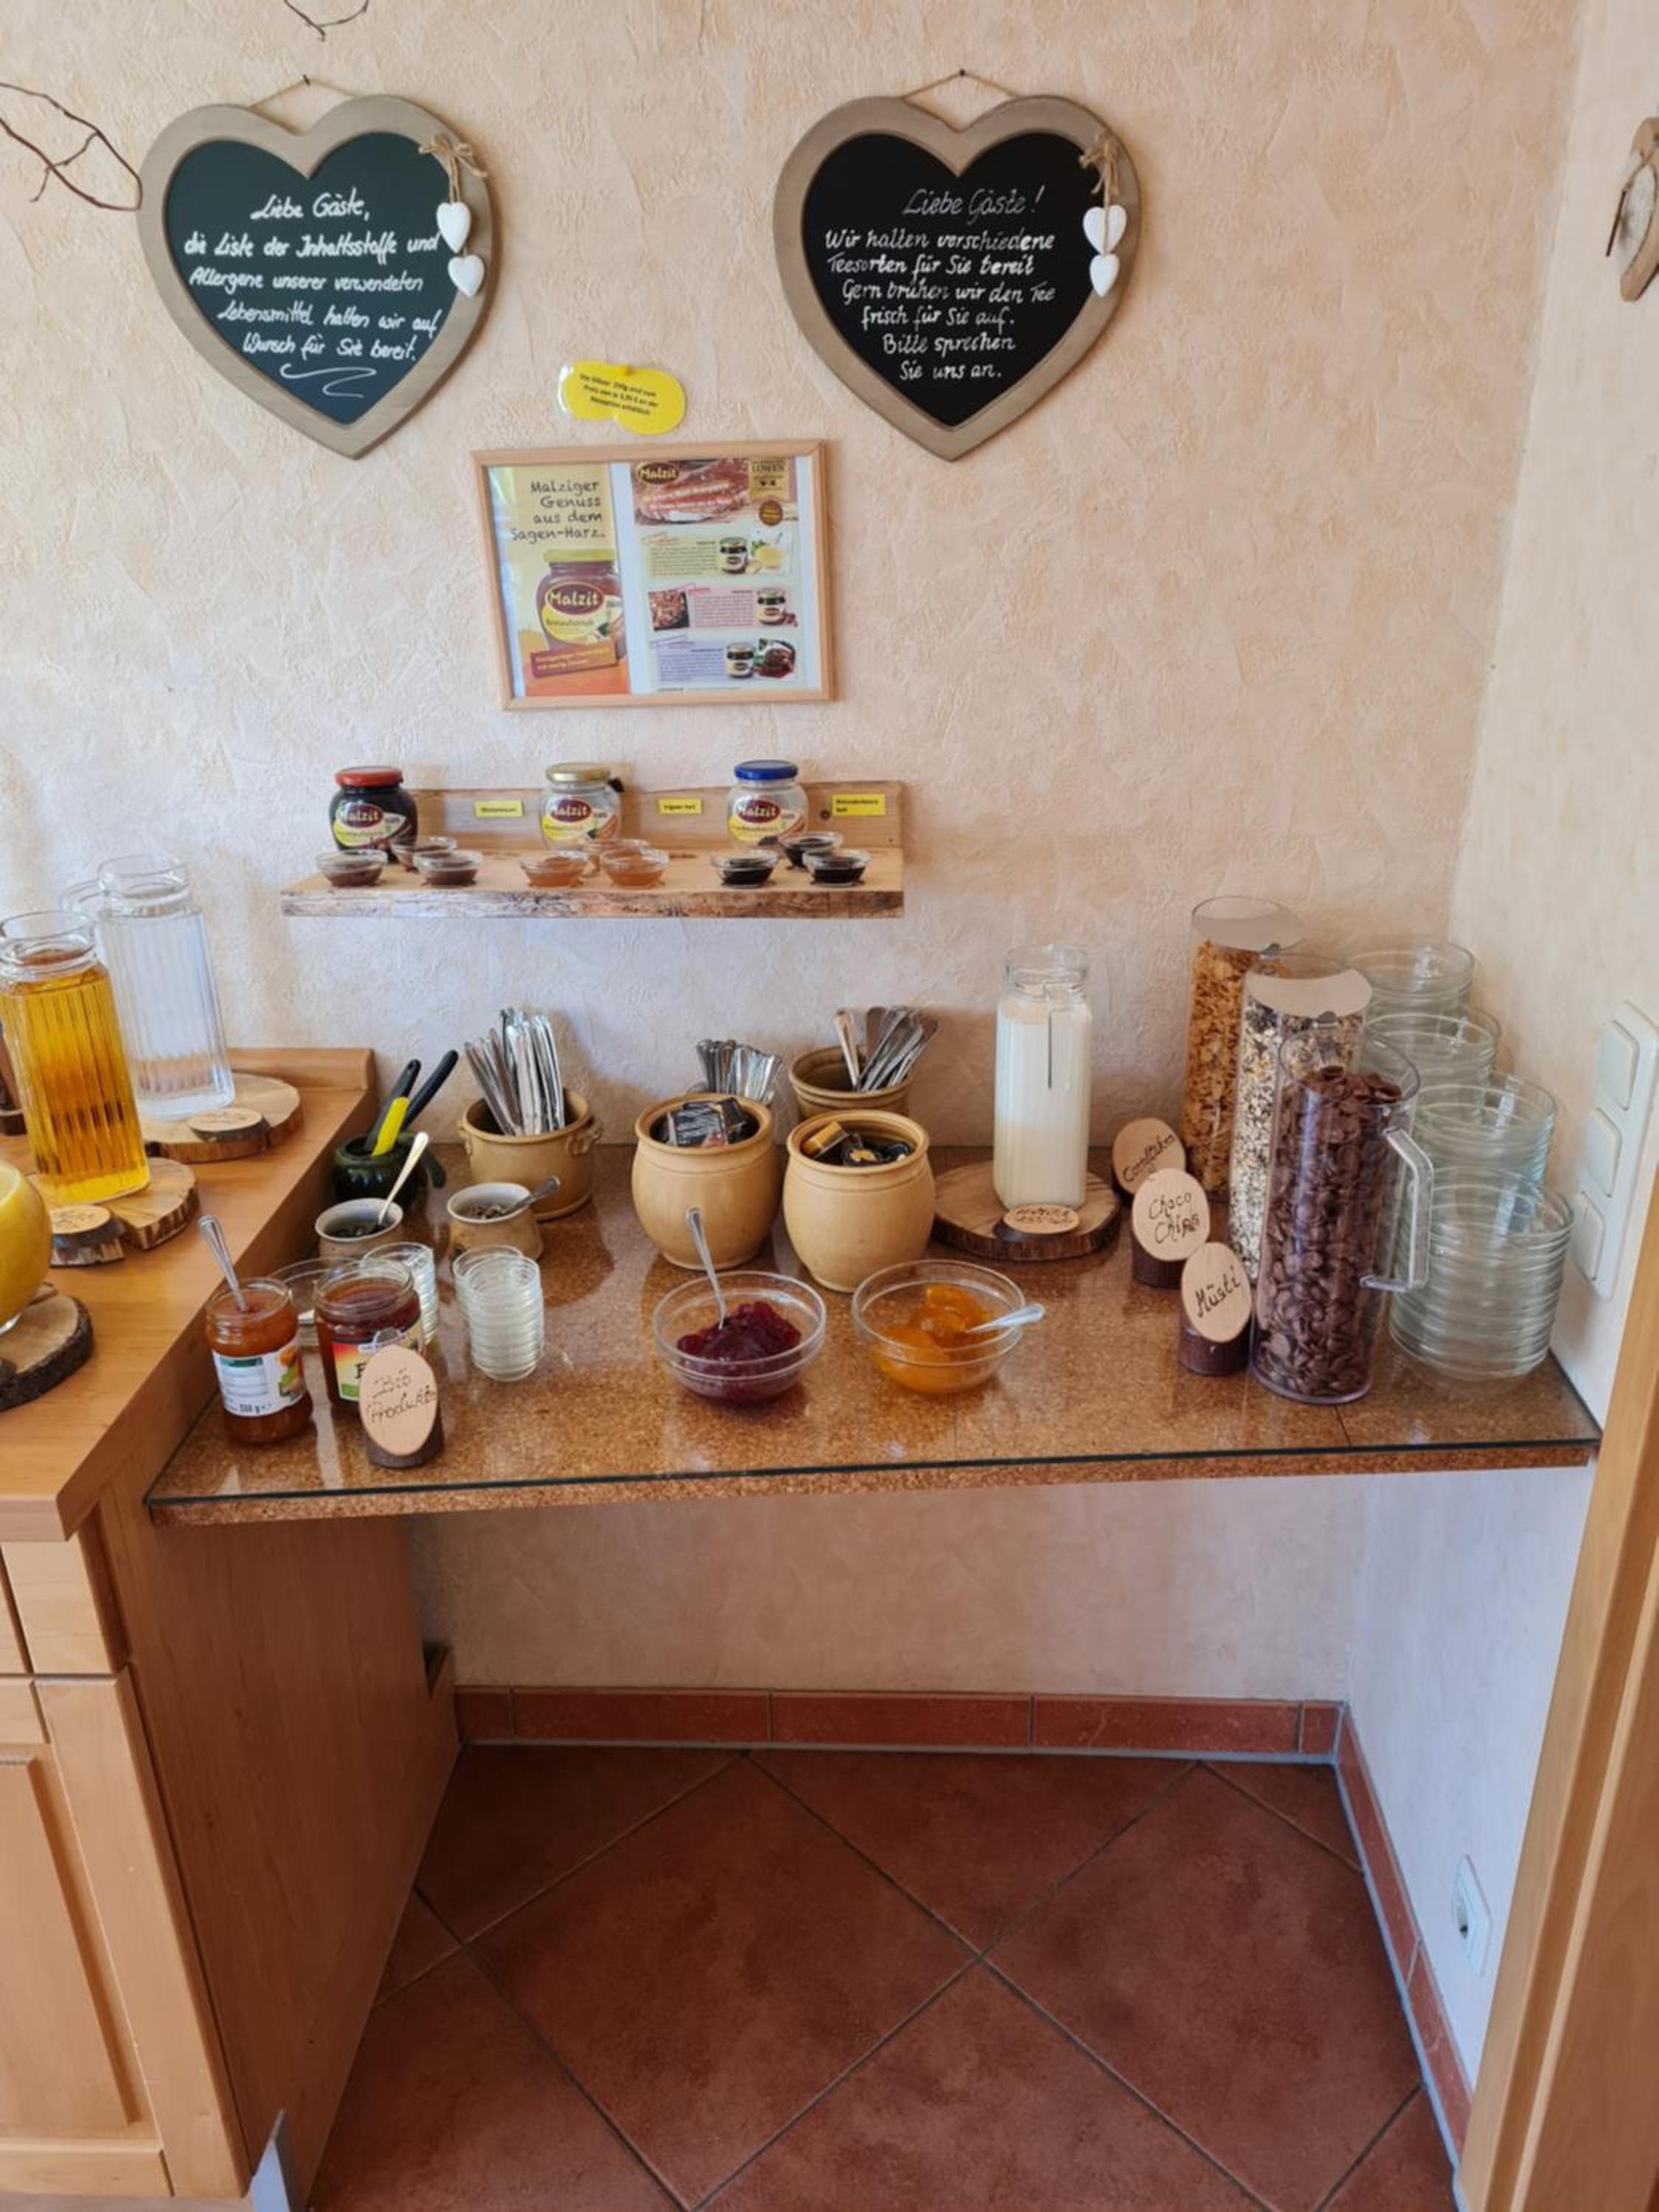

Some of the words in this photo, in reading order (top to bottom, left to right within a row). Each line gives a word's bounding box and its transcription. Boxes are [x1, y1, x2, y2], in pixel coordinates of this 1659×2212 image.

[250, 195, 304, 220] Liebe
[902, 189, 962, 215] Liebe
[967, 189, 1025, 224] Gäste
[184, 231, 206, 254] die
[214, 232, 254, 257] Liste
[263, 236, 290, 257] der
[296, 231, 397, 265] Inhaltsstoffe
[407, 232, 440, 253] und
[826, 229, 861, 248] Wir
[866, 228, 929, 248] halten
[189, 266, 263, 295] Allergene
[273, 276, 327, 291] unserer
[912, 254, 941, 283] für
[945, 254, 972, 274] Sie
[843, 279, 883, 305] Gern
[956, 282, 984, 299] wir
[989, 283, 1023, 303] den
[1030, 282, 1055, 302] Tee
[217, 299, 313, 325] Lebensmittel
[323, 305, 369, 327] halten
[378, 313, 406, 329] wir
[412, 309, 442, 339] auf
[861, 305, 908, 330] frisch
[913, 305, 940, 331] für
[946, 307, 970, 325] Sie
[975, 306, 1014, 335] auf.
[243, 332, 296, 354] Wunsch
[301, 334, 325, 360] für
[336, 338, 363, 356] Sie
[370, 335, 417, 361] bereit.
[900, 360, 922, 380] Sie
[933, 365, 965, 379] uns
[970, 364, 1001, 378] an.
[531, 479, 599, 496] Malziger
[540, 495, 602, 508] Genuss
[532, 513, 561, 524] aus
[567, 509, 602, 523] dem
[548, 590, 599, 606] Malzit
[1147, 1191, 1193, 1221] Choco
[1196, 1264, 1242, 1318] Müsli
